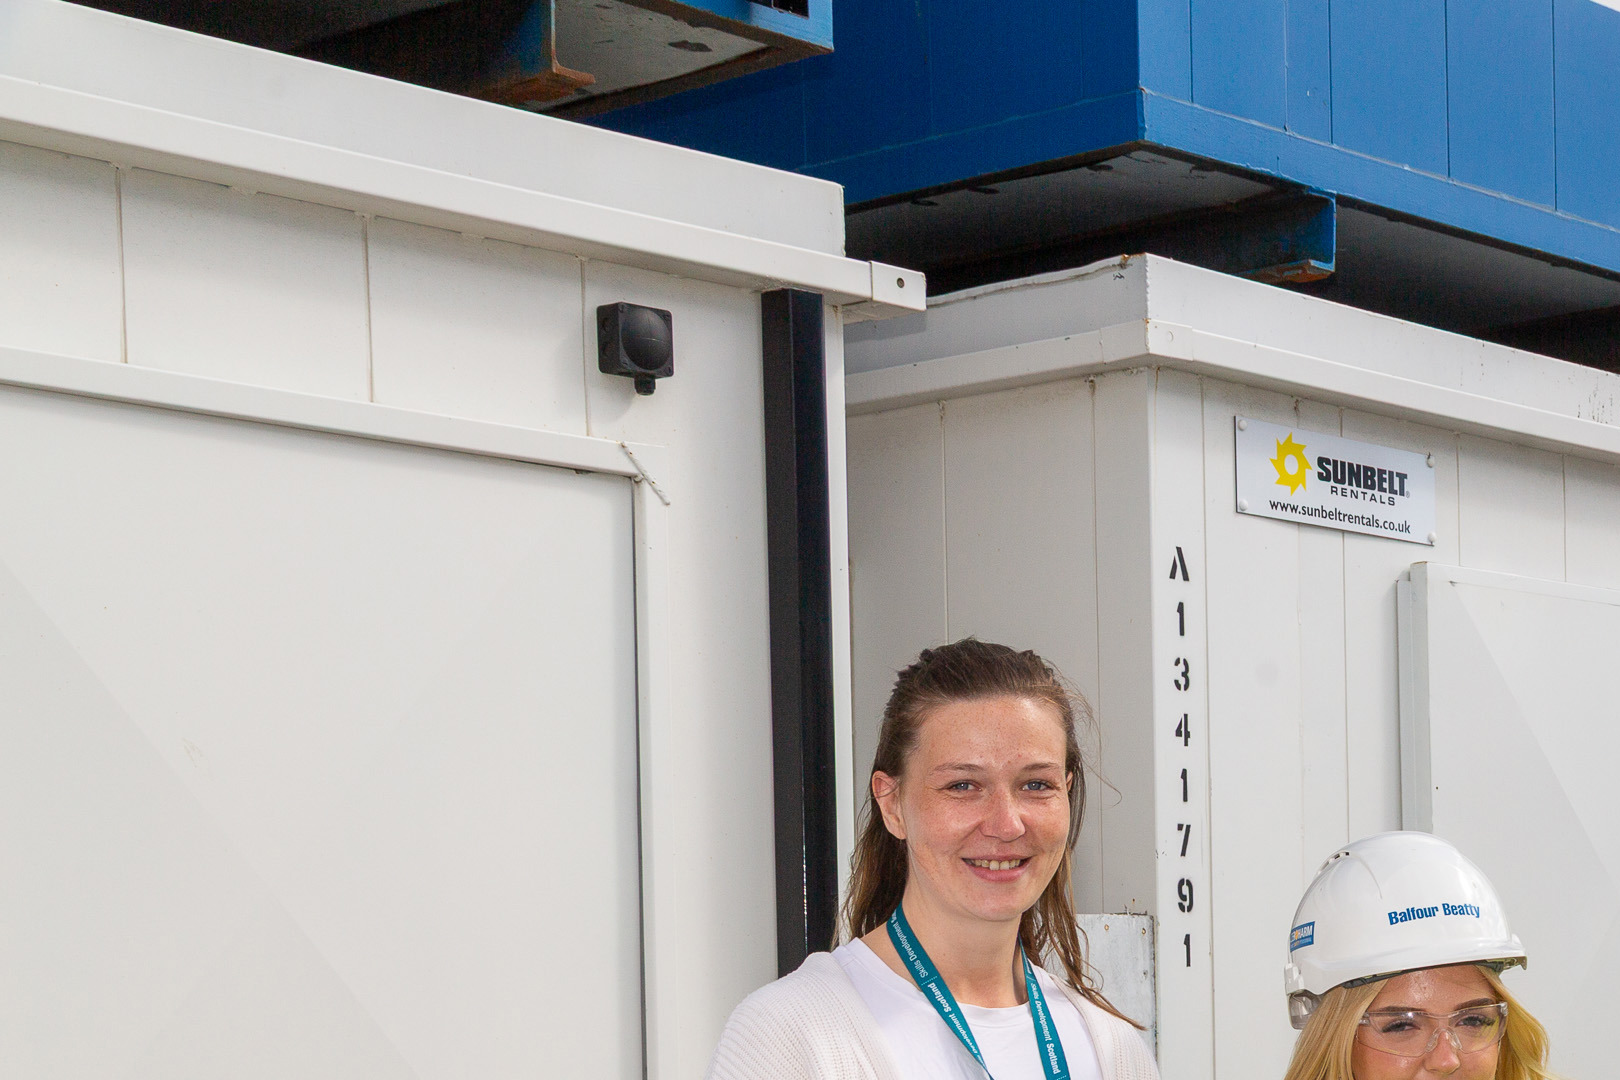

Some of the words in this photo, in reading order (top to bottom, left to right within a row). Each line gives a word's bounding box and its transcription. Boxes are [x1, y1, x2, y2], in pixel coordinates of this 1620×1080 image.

[1316, 456, 1408, 497] SUNBELT
[1330, 485, 1396, 506] RENTALS
[1269, 500, 1411, 534] www.sunbeltrentals.co.uk
[1388, 906, 1439, 925] Balfour
[1442, 903, 1480, 918] Beatty
[892, 921, 918, 962] Development
[914, 959, 929, 979] Skills
[928, 983, 952, 1014] Scotland
[1034, 1000, 1052, 1041] Development
[1046, 1043, 1061, 1075] Scotland
